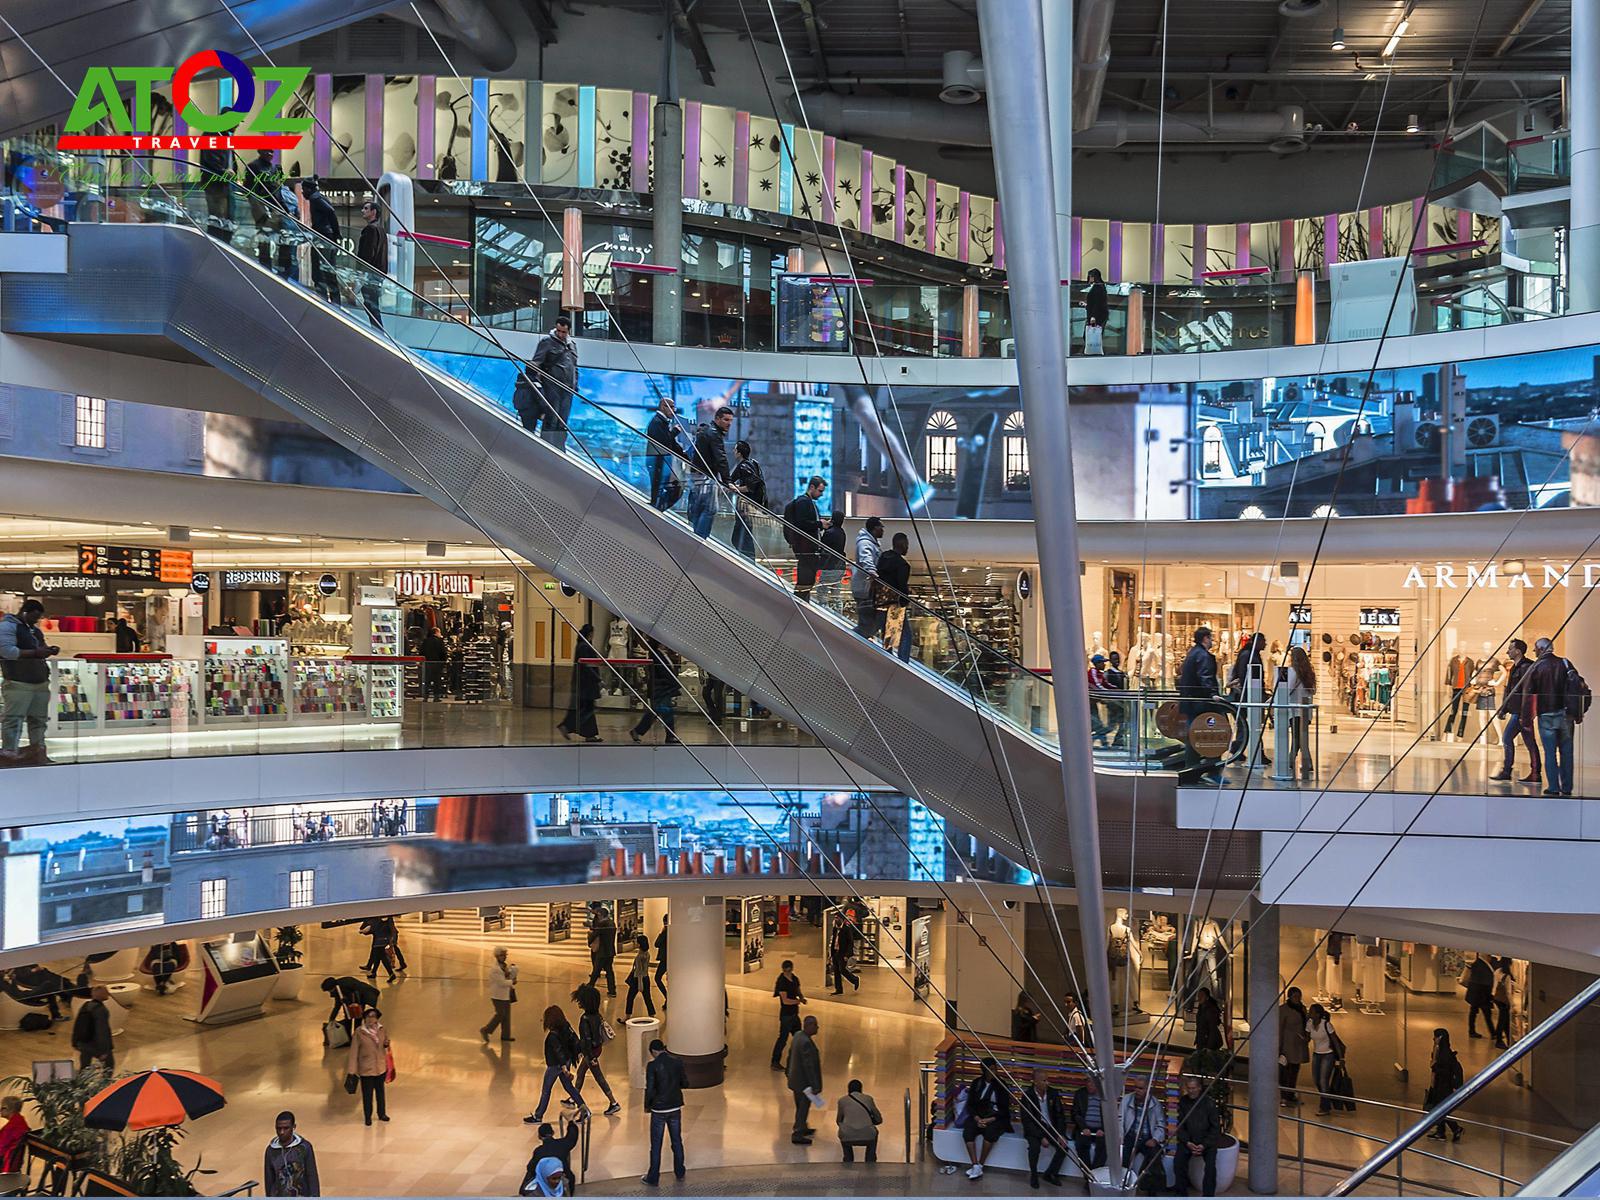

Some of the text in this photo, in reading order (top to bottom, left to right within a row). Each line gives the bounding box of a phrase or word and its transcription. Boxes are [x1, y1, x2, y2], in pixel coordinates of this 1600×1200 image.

[81, 551, 95, 575] 2
[225, 570, 281, 585] REDSKINS
[442, 575, 470, 593] CUIR
